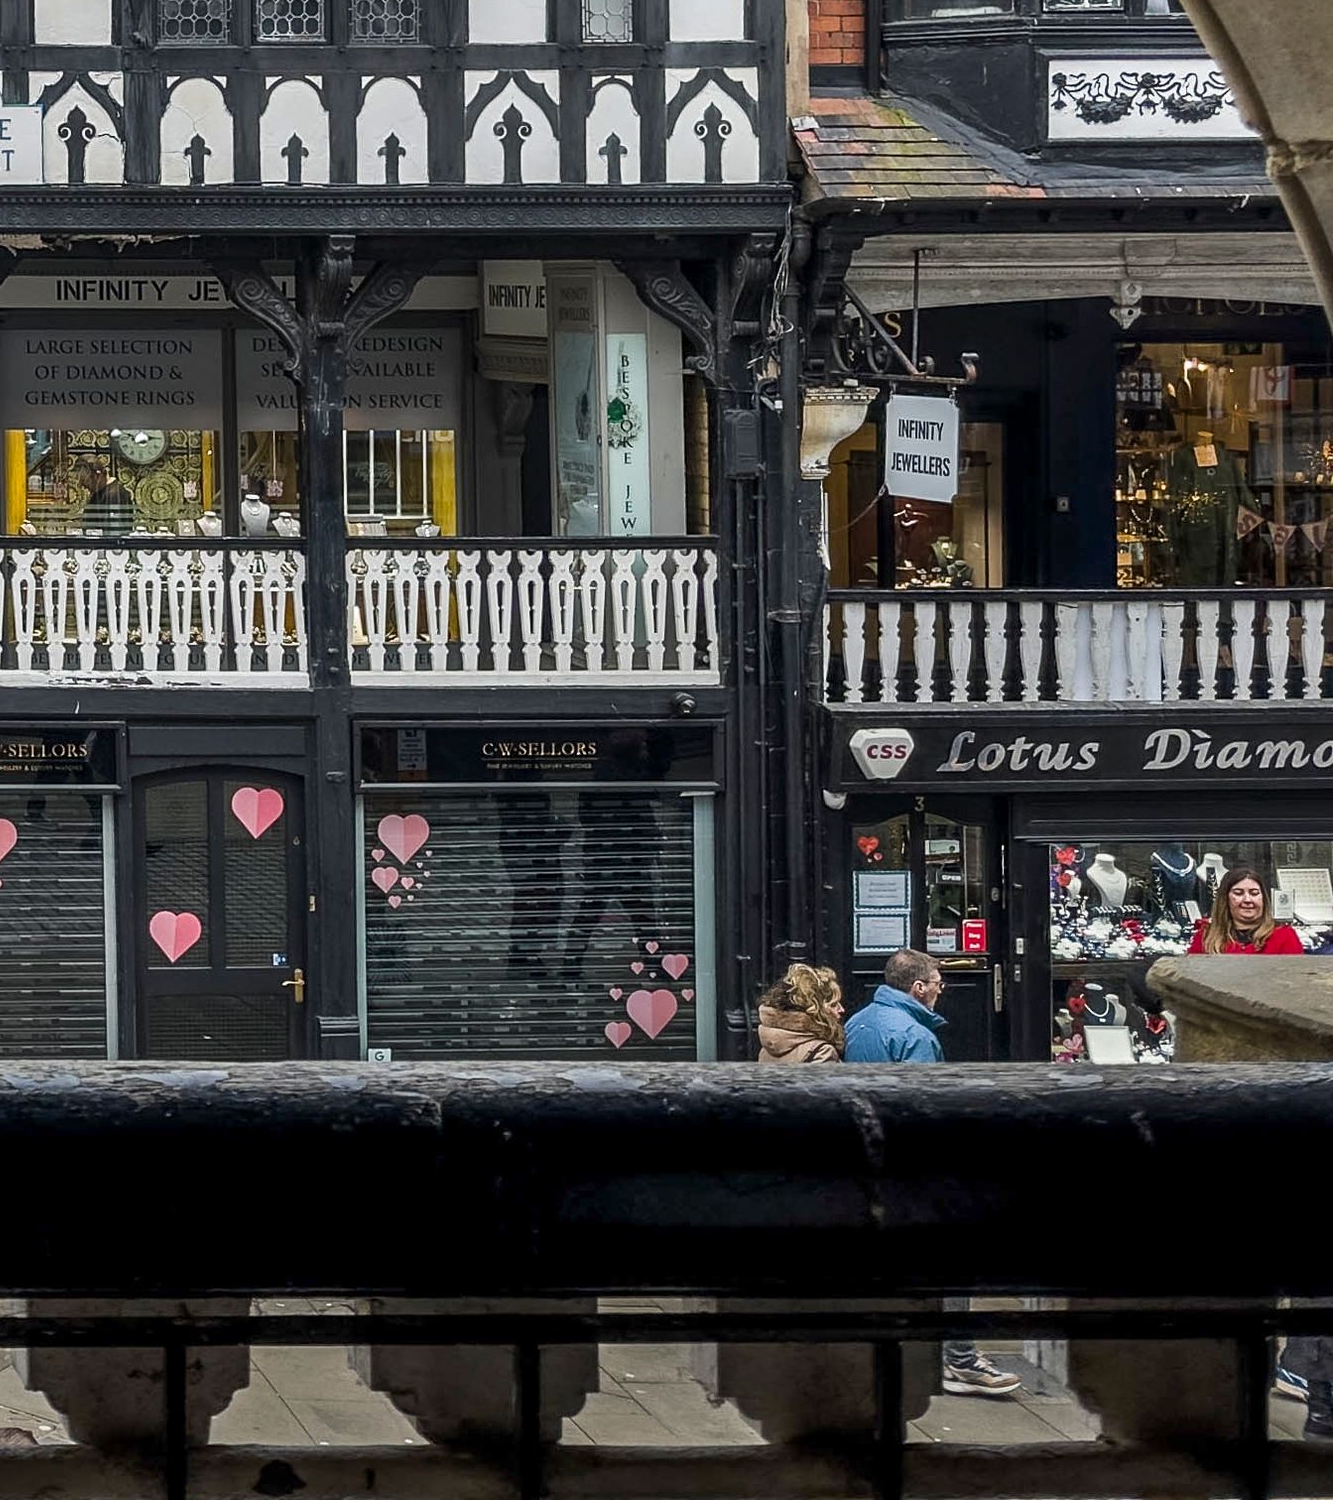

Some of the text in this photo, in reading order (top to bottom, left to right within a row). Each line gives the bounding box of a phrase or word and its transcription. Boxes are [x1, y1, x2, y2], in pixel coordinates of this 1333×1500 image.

[56, 280, 169, 301] INFINITY
[488, 285, 531, 308] INFINITY
[25, 339, 193, 355] LARGE SELECTION
[35, 365, 183, 381] OF DIAMOND &
[355, 364, 435, 378] AILABLE
[25, 391, 195, 406] GEMSTONE RINGS
[368, 394, 443, 409] SERVICE
[898, 418, 944, 441] INFINITY
[891, 451, 951, 477] JEWELLERS
[936, 729, 1100, 773] Lotus
[914, 797, 925, 812] 3
